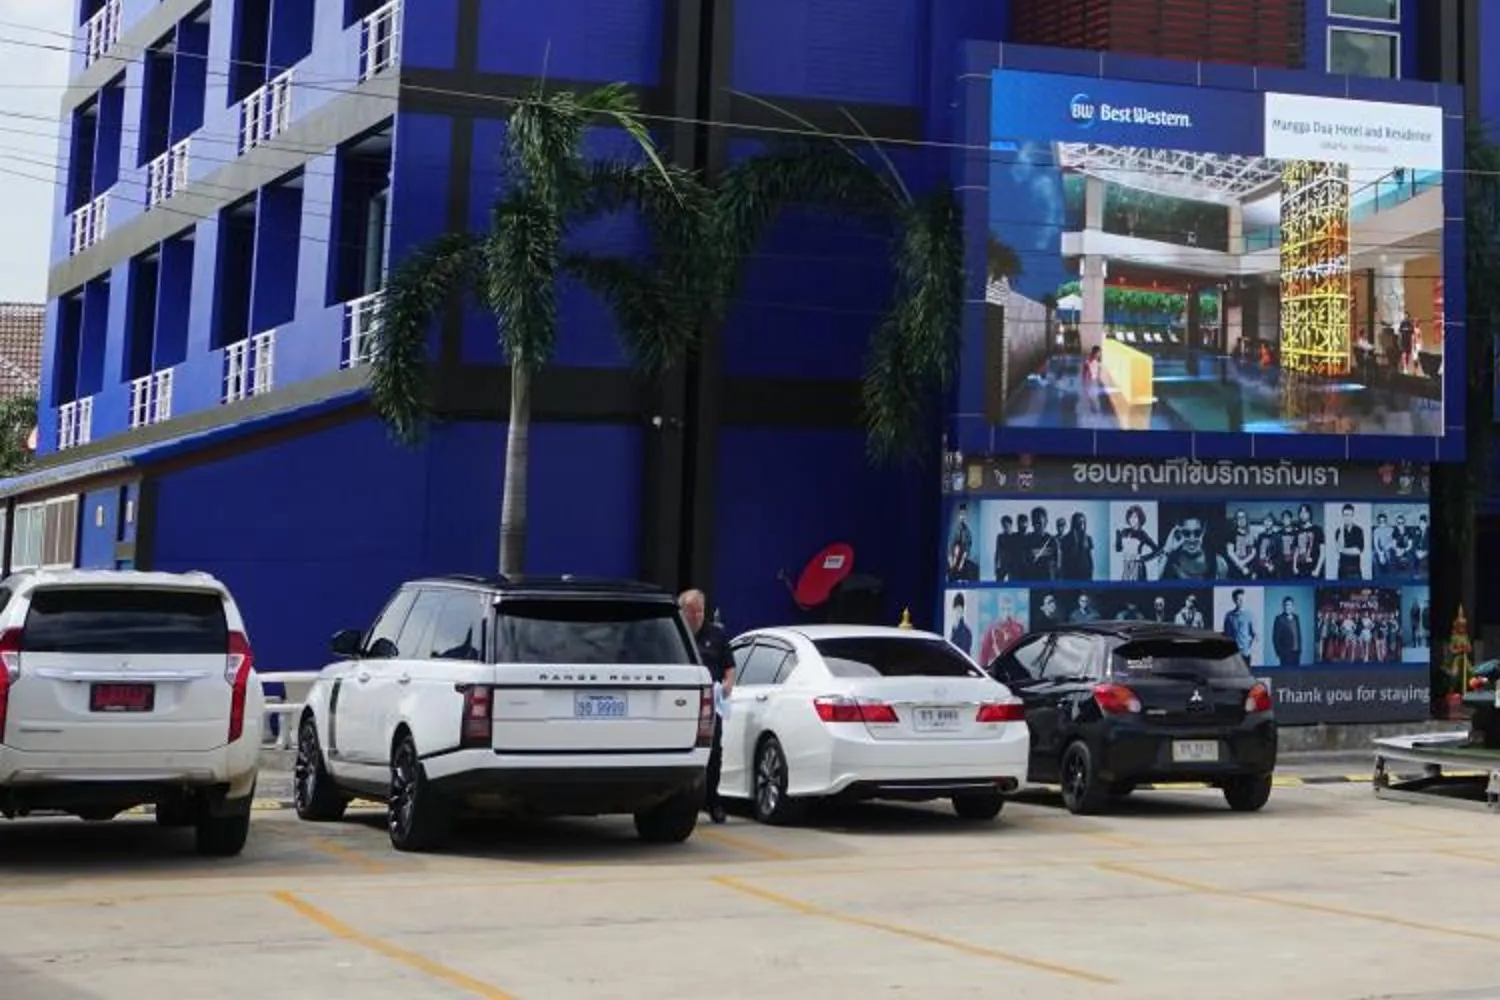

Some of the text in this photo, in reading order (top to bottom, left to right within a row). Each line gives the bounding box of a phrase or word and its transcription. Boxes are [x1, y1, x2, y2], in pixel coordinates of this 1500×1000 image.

[1101, 103, 1132, 123] Best
[1133, 106, 1190, 128] Western
[1272, 119, 1311, 135] Mangga
[1313, 121, 1333, 137] Dua
[1335, 123, 1363, 137] Hotel
[1364, 125, 1383, 139] and
[539, 673, 665, 682] RANGE ROVER
[1276, 684, 1430, 705] Thank you for staying
